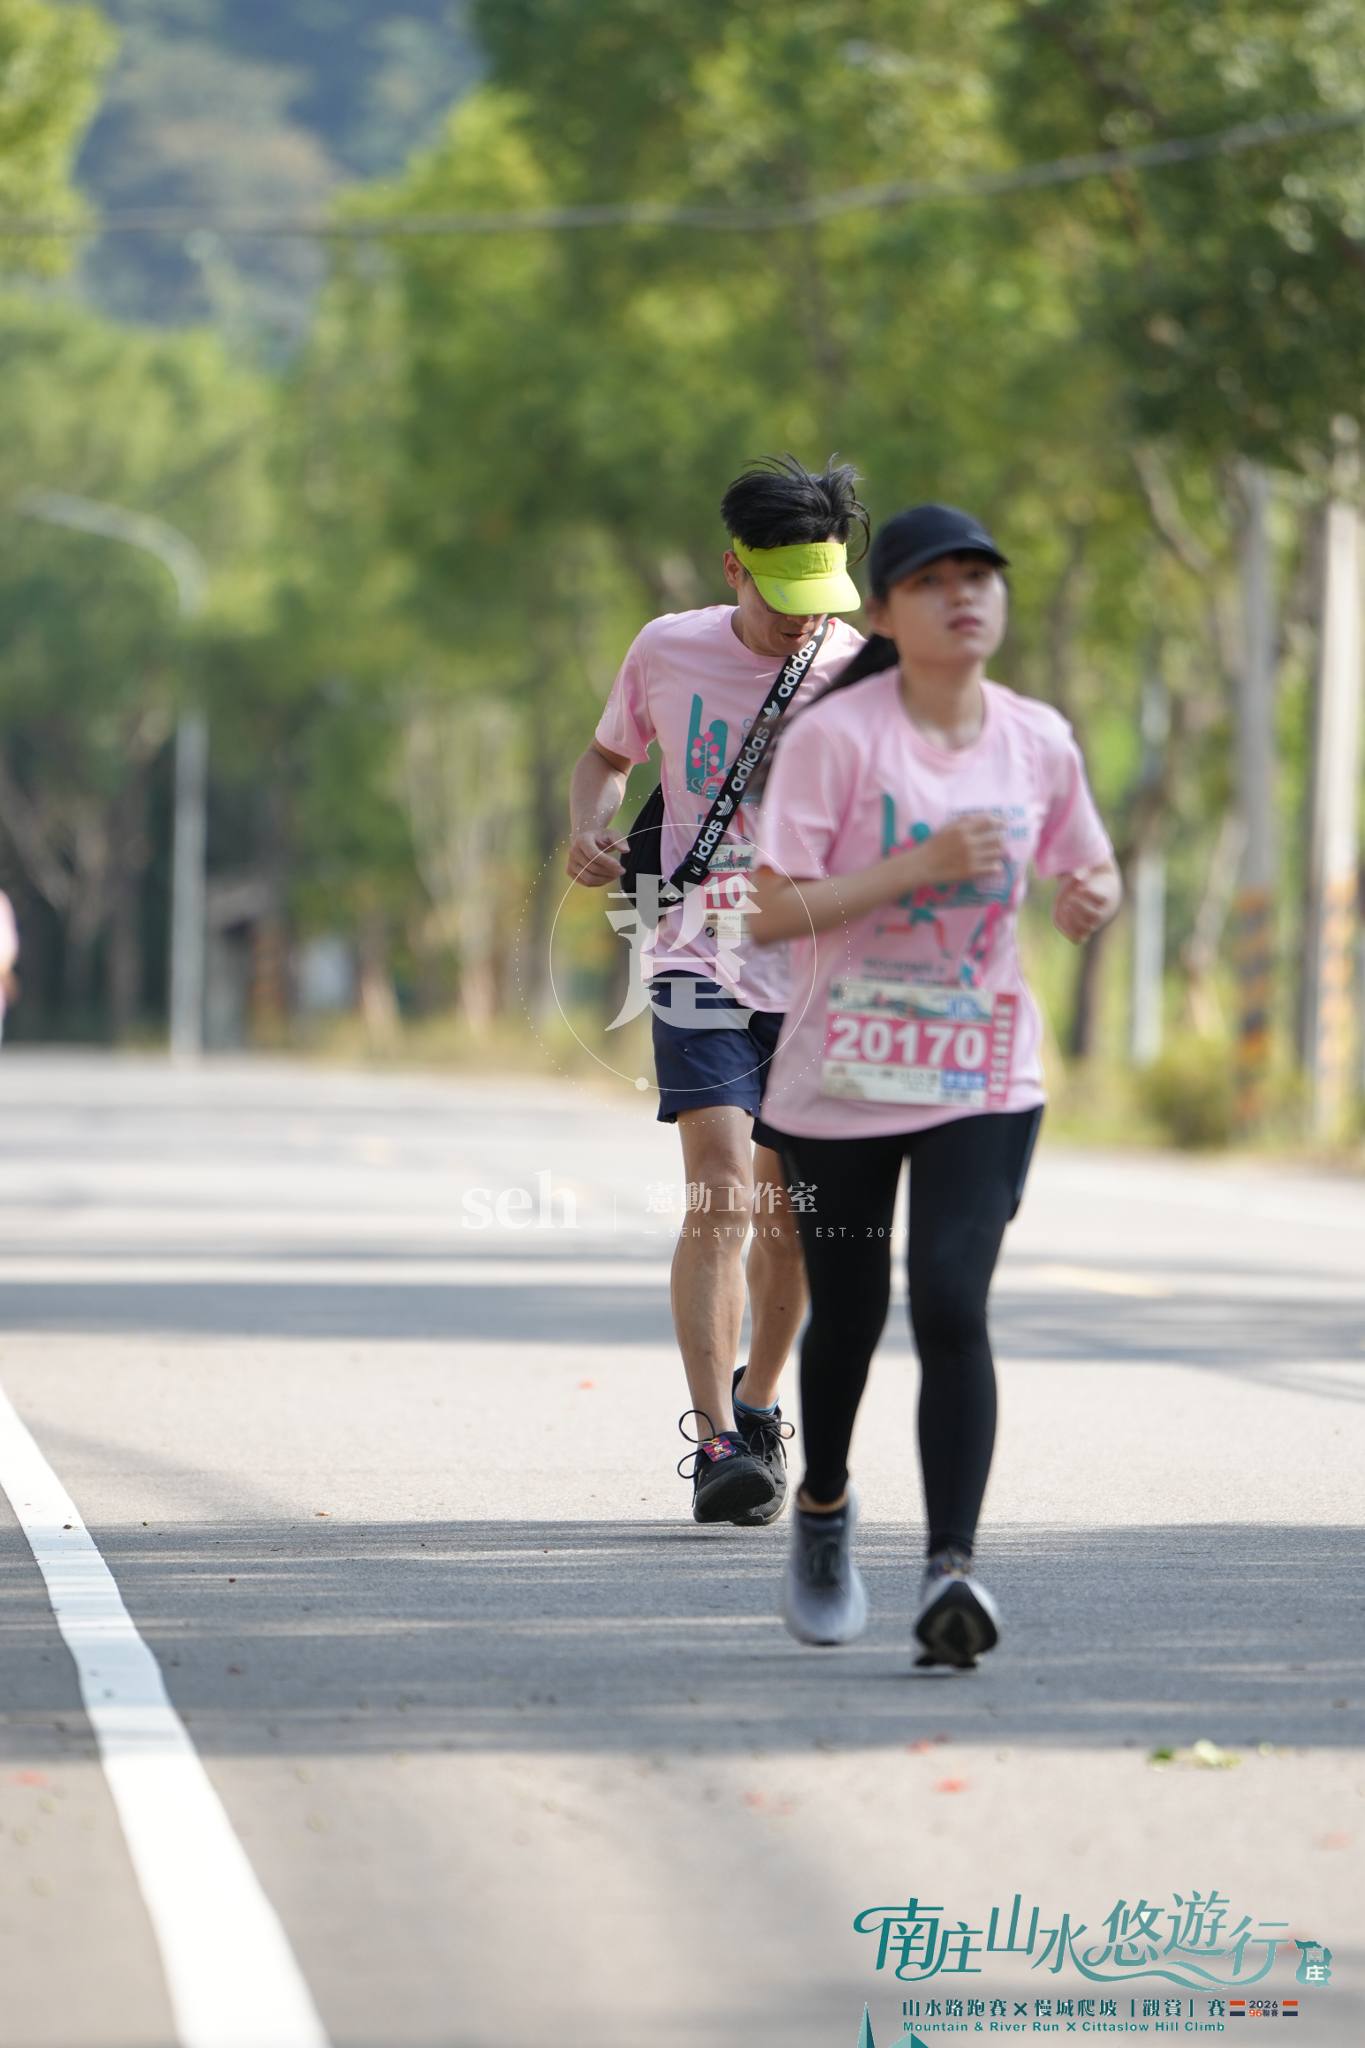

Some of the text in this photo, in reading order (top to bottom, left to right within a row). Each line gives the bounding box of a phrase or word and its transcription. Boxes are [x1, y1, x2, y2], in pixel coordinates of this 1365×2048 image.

[778, 639, 816, 698] adidas
[731, 726, 770, 792] adidas
[692, 820, 723, 861] idas
[829, 1018, 987, 1070] 20170
